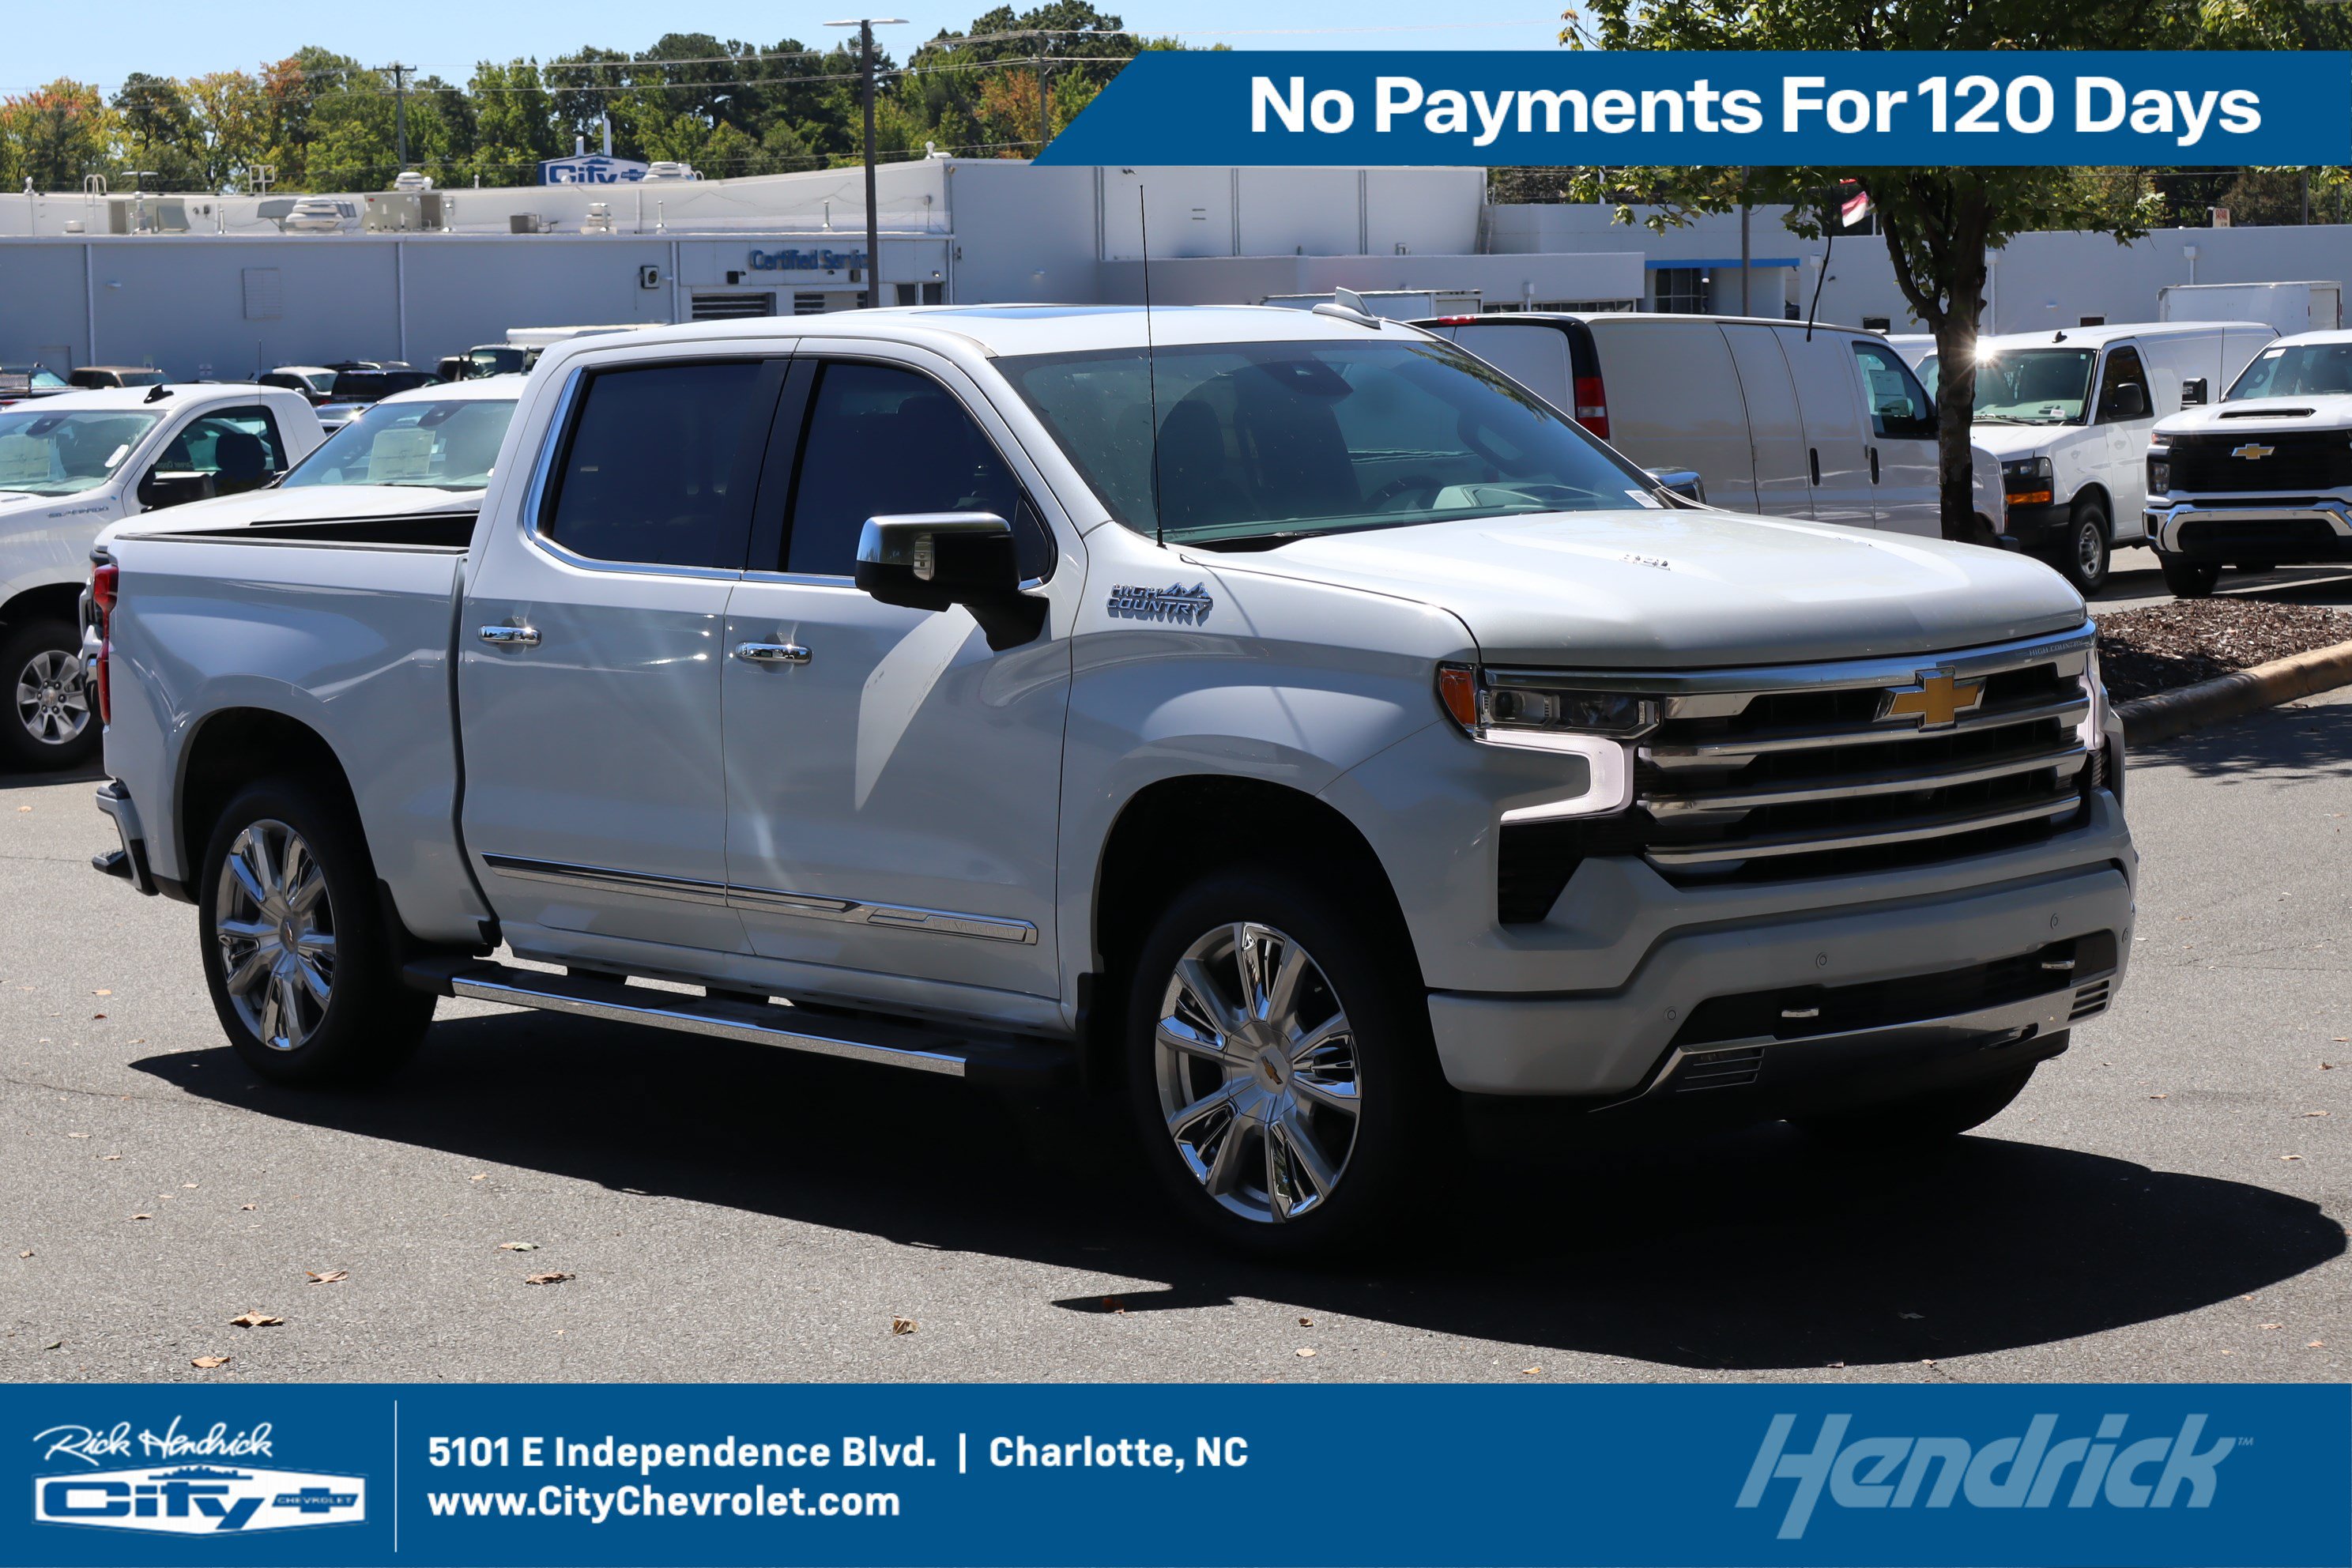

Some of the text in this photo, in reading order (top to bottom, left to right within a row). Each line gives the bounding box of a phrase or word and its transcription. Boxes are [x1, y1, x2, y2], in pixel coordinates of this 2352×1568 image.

[549, 164, 618, 183] City
[750, 249, 869, 270] Certified Servic
[1111, 583, 1164, 599] HIGH
[1107, 597, 1209, 616] COUNTRY
[2029, 646, 2049, 657] HIGH
